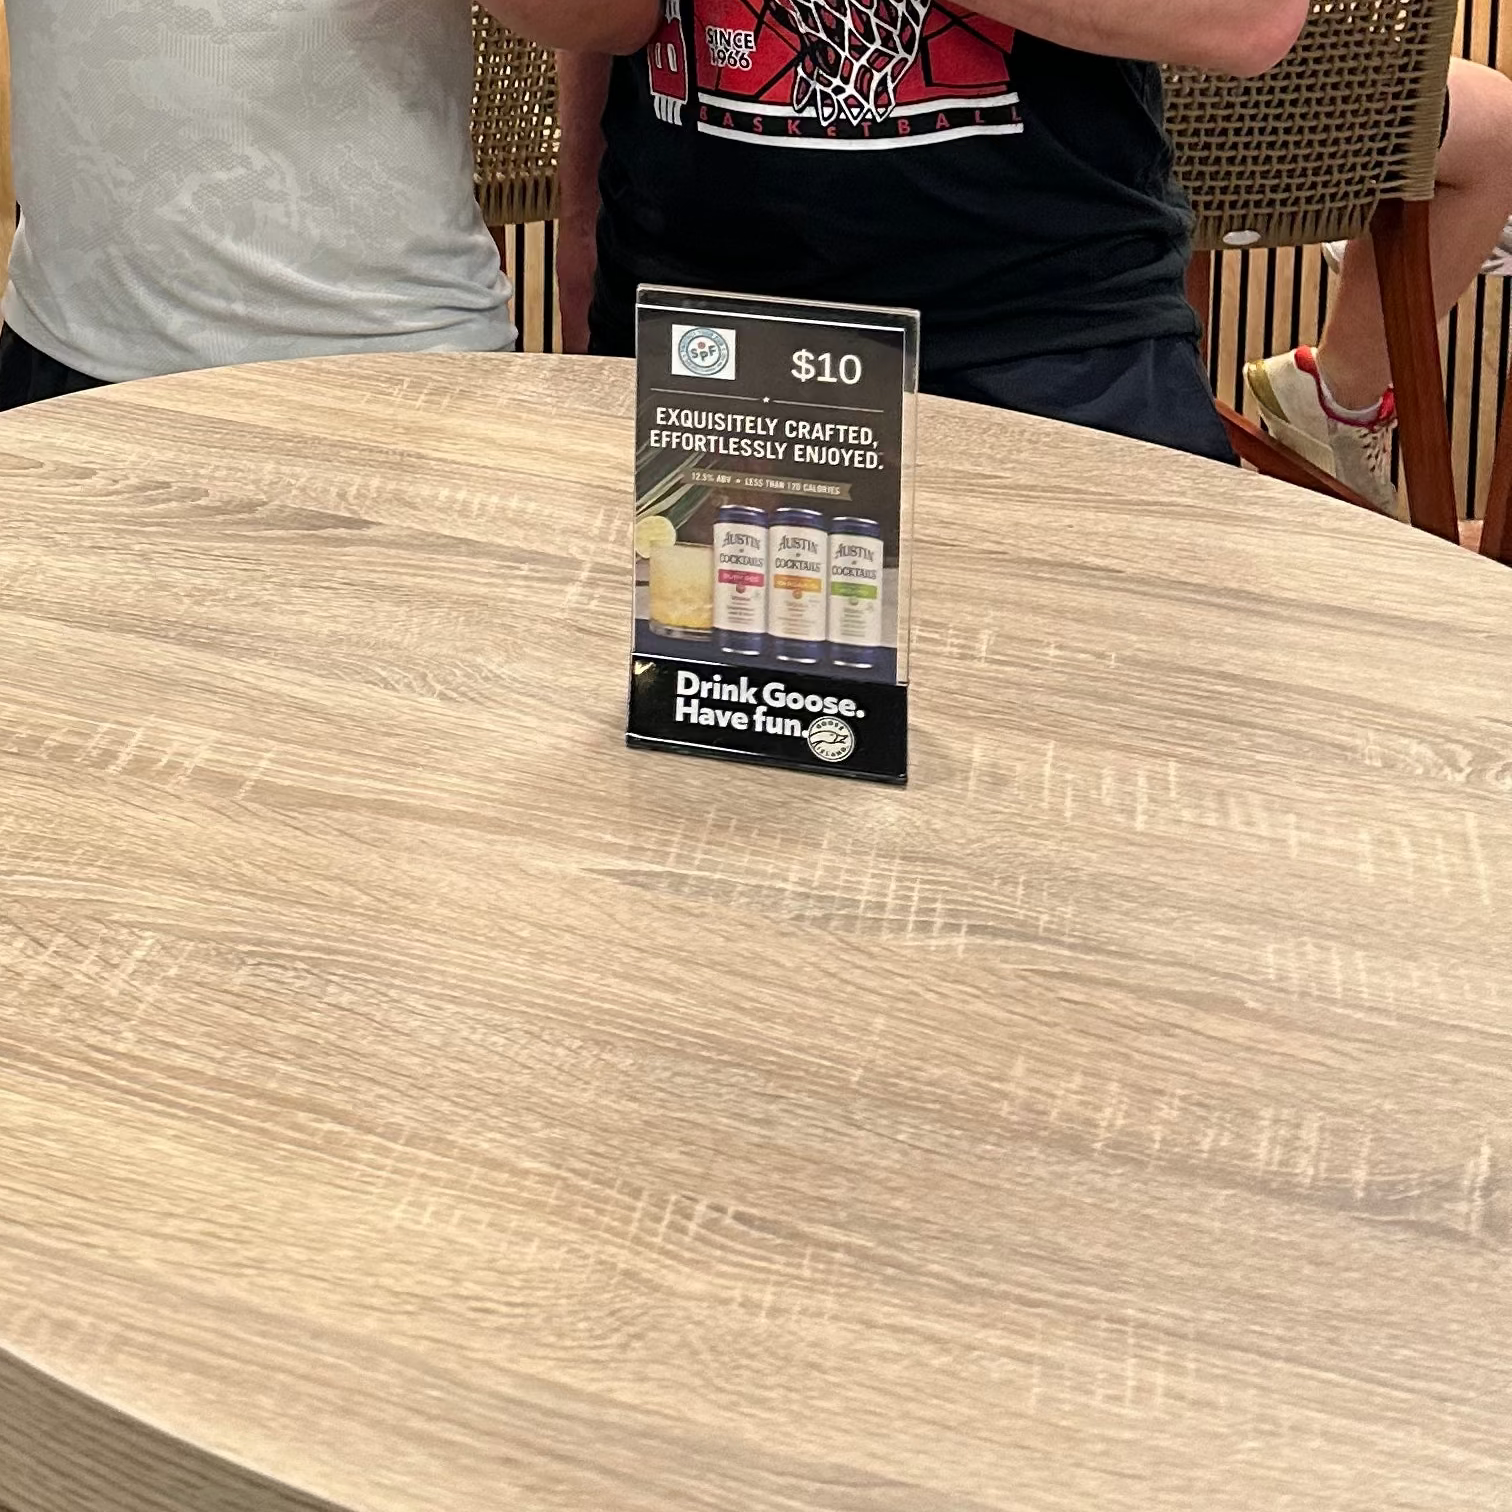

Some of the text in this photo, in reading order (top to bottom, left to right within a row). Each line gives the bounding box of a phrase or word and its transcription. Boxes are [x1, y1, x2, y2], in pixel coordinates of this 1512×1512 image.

[706, 26, 756, 51] SINCE
[710, 45, 753, 71] 1966
[690, 344, 717, 362] SPF
[791, 348, 862, 385] $10
[656, 407, 879, 449] EXQUISITELY CRAFTED,
[650, 429, 884, 470] EFFORTLESSLY ENJOYED.
[677, 670, 865, 719] Drink Goose.
[675, 696, 809, 738] Have fun.
